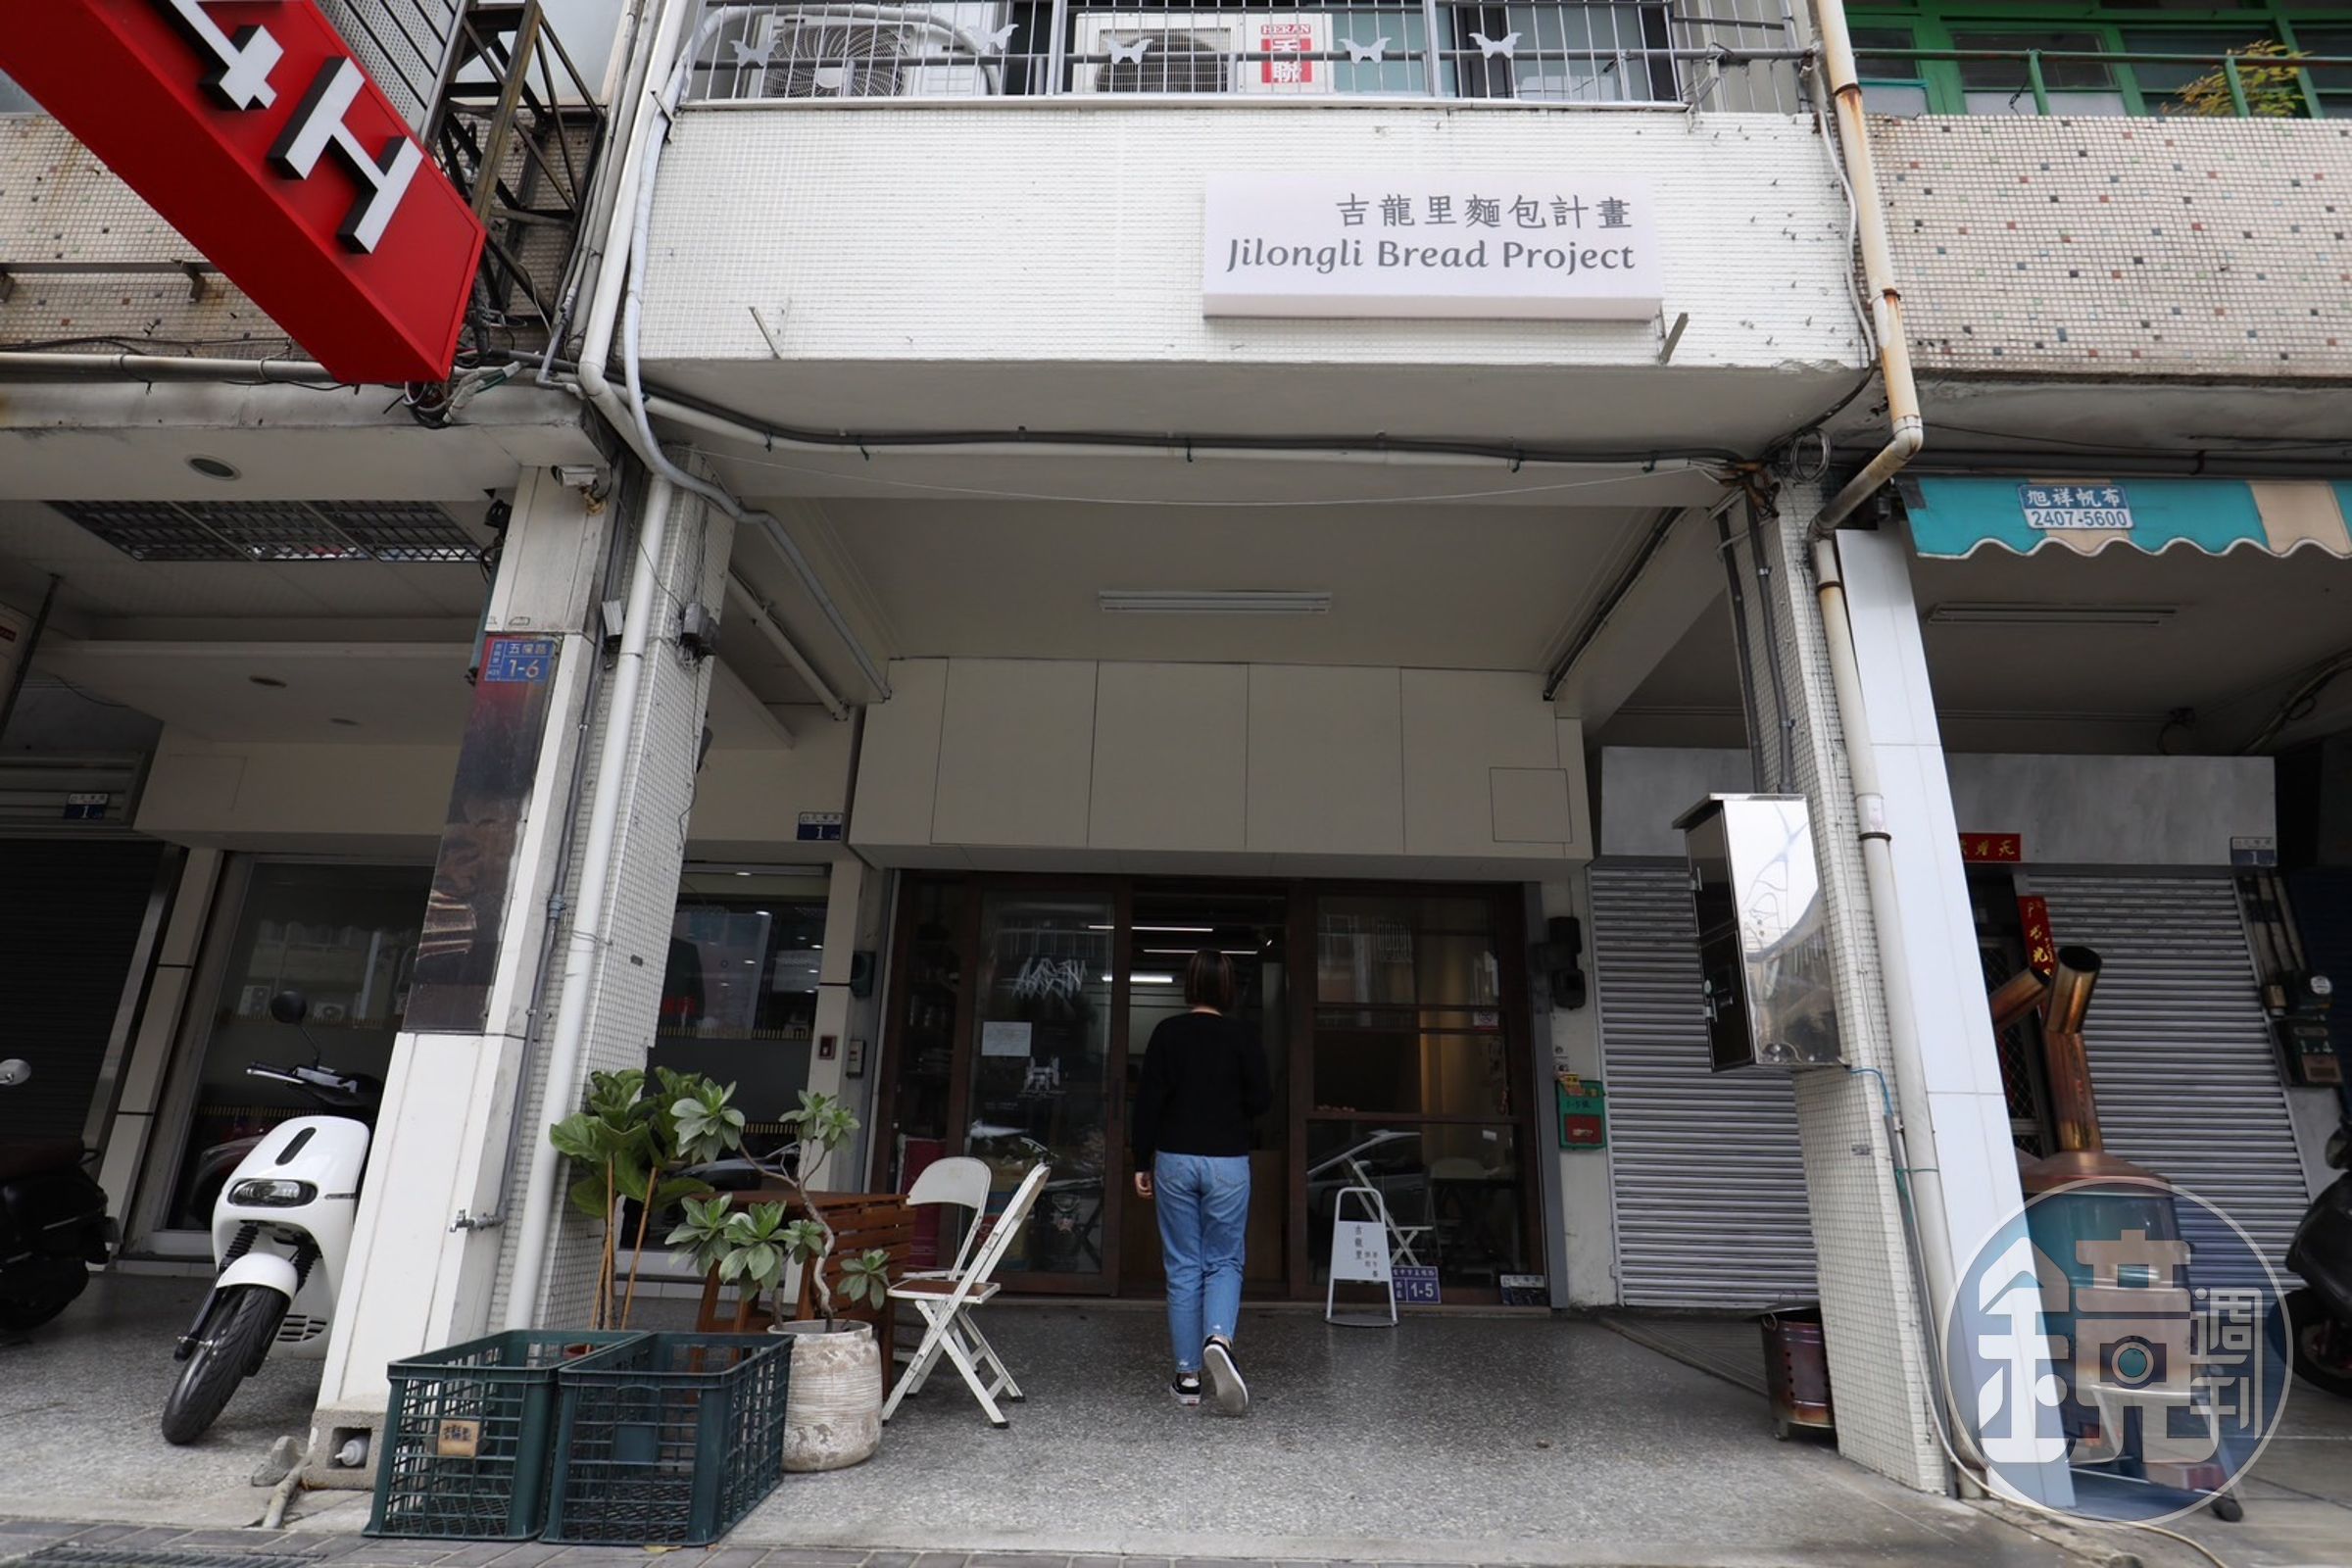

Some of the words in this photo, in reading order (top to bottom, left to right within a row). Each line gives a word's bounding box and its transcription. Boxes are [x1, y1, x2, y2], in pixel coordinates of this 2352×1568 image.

[1336, 192, 1633, 229] 吉龍里麵包計畫
[1226, 238, 1364, 274] Jilongli
[1378, 240, 1489, 269] Bread
[1502, 241, 1636, 275] Project
[2026, 487, 2123, 509] 旭祥帆布
[2032, 511, 2128, 526] 2407-5600
[509, 659, 540, 678] 1-6
[1410, 1282, 1435, 1298] 1-5
